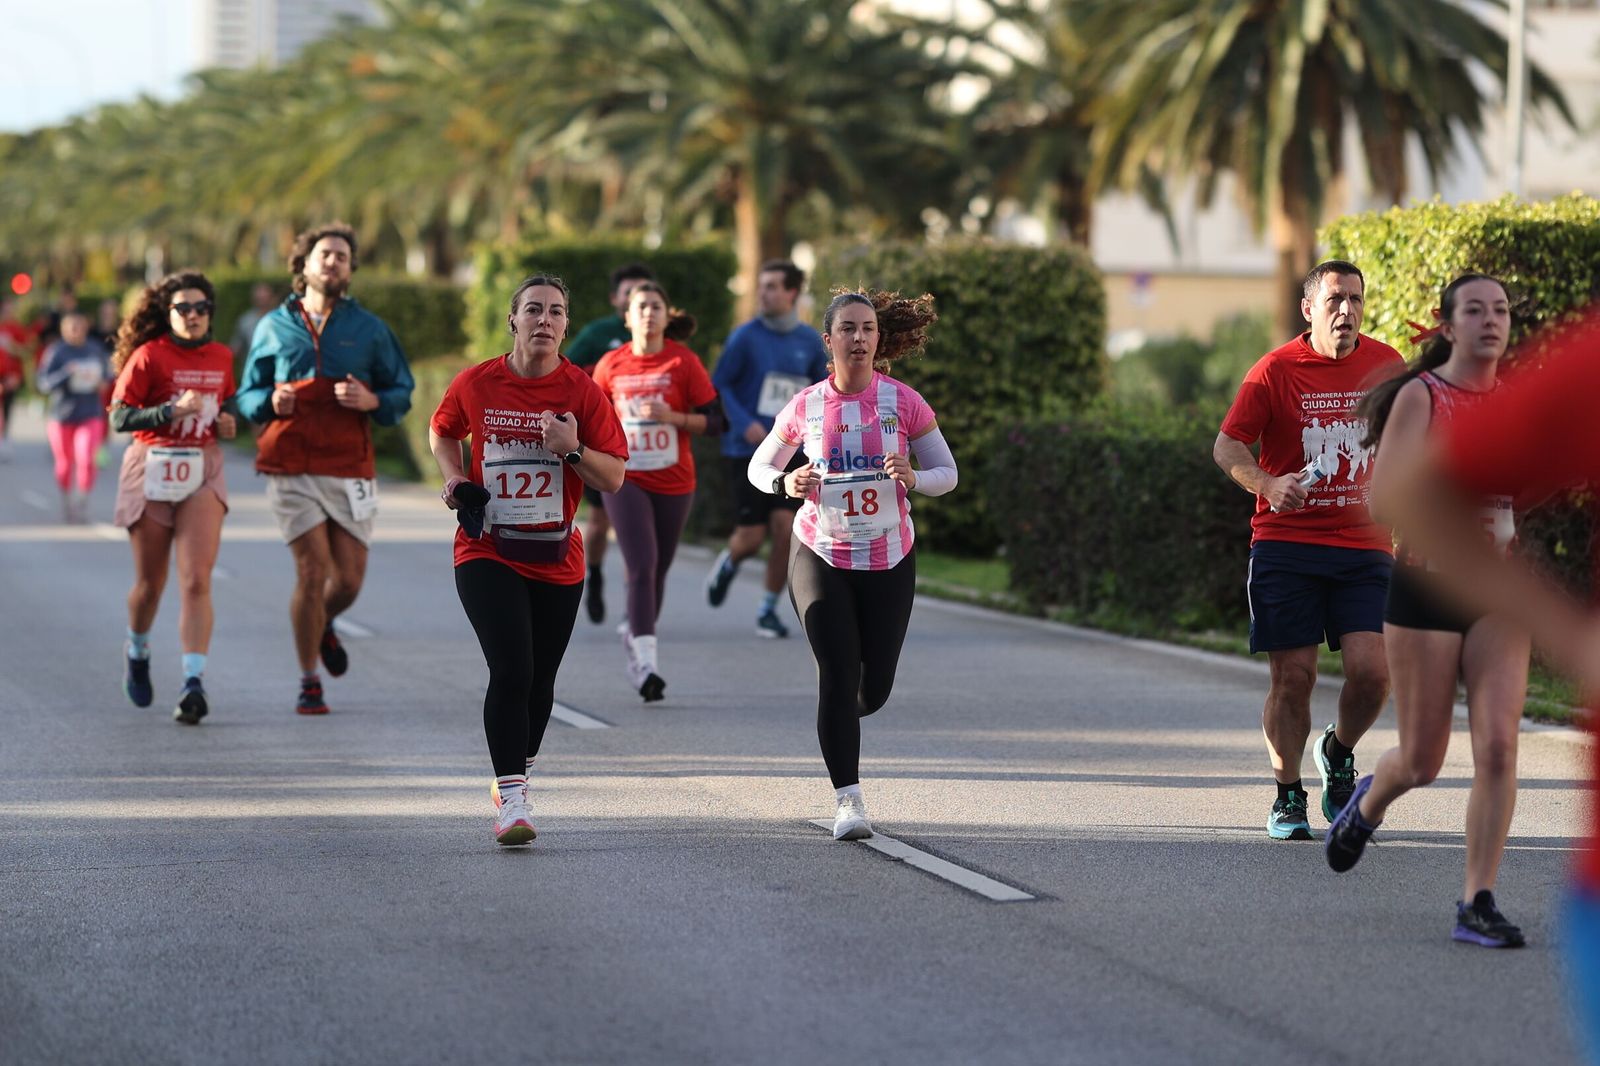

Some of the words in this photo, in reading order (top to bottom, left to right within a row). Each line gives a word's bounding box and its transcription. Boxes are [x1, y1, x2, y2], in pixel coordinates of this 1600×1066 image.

[1344, 390, 1368, 398] URBAN
[1302, 400, 1340, 409] CIUDAD
[495, 410, 525, 418] CARRERA
[484, 416, 521, 426] CIUDAD
[630, 430, 670, 451] 110
[163, 461, 190, 482] 10
[496, 471, 552, 498] 122
[1335, 484, 1358, 492] febrero
[842, 488, 879, 516] 18
